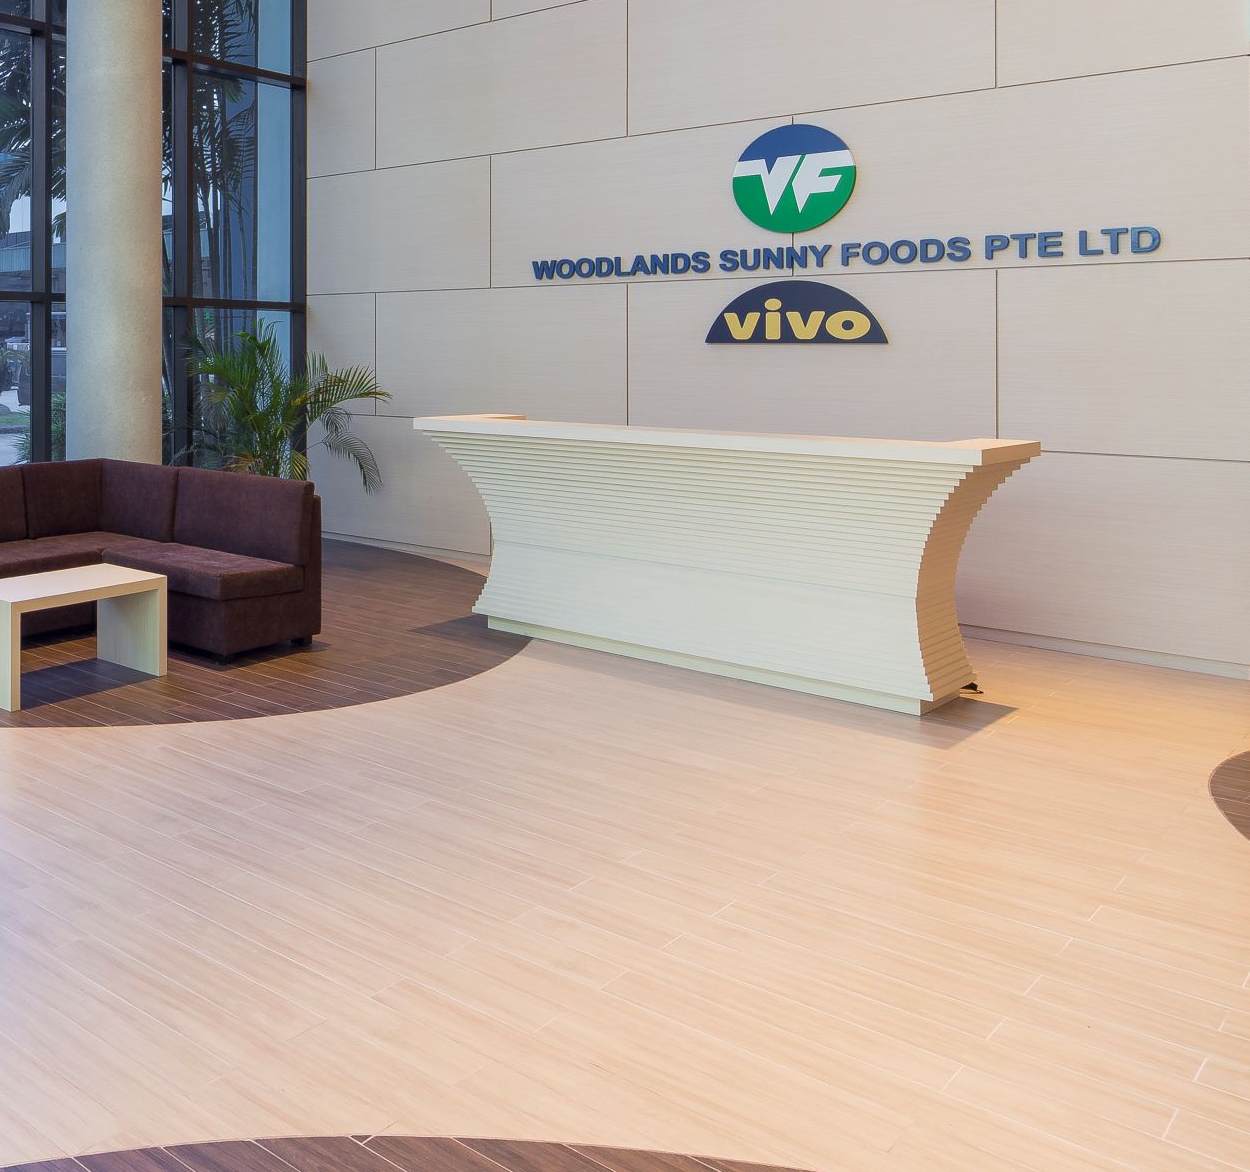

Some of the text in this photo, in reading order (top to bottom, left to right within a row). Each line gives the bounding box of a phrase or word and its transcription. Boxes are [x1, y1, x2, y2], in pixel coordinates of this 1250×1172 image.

[532, 226, 1162, 280] WOODLANDS SUNNY FOODS PTE LTD
[723, 298, 871, 341] vivo
